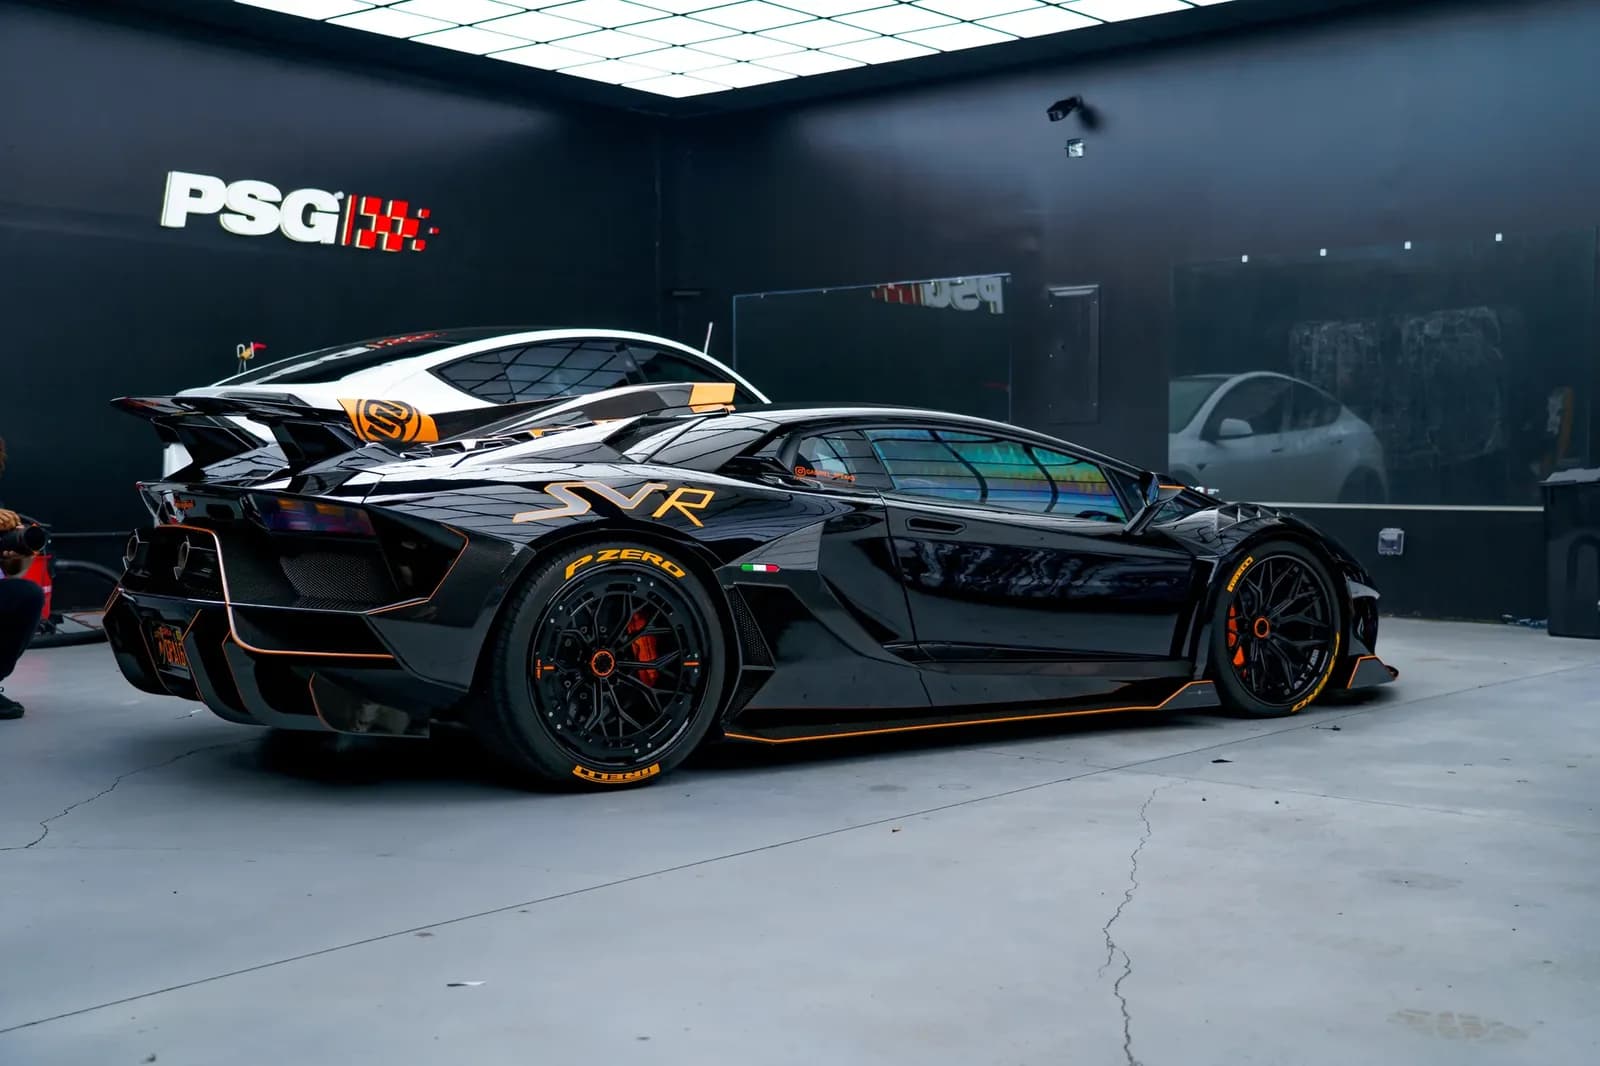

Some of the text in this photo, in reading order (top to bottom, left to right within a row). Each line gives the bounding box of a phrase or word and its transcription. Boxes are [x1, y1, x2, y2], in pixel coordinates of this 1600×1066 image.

[161, 170, 341, 244] PSG
[565, 549, 686, 580] P ZERO
